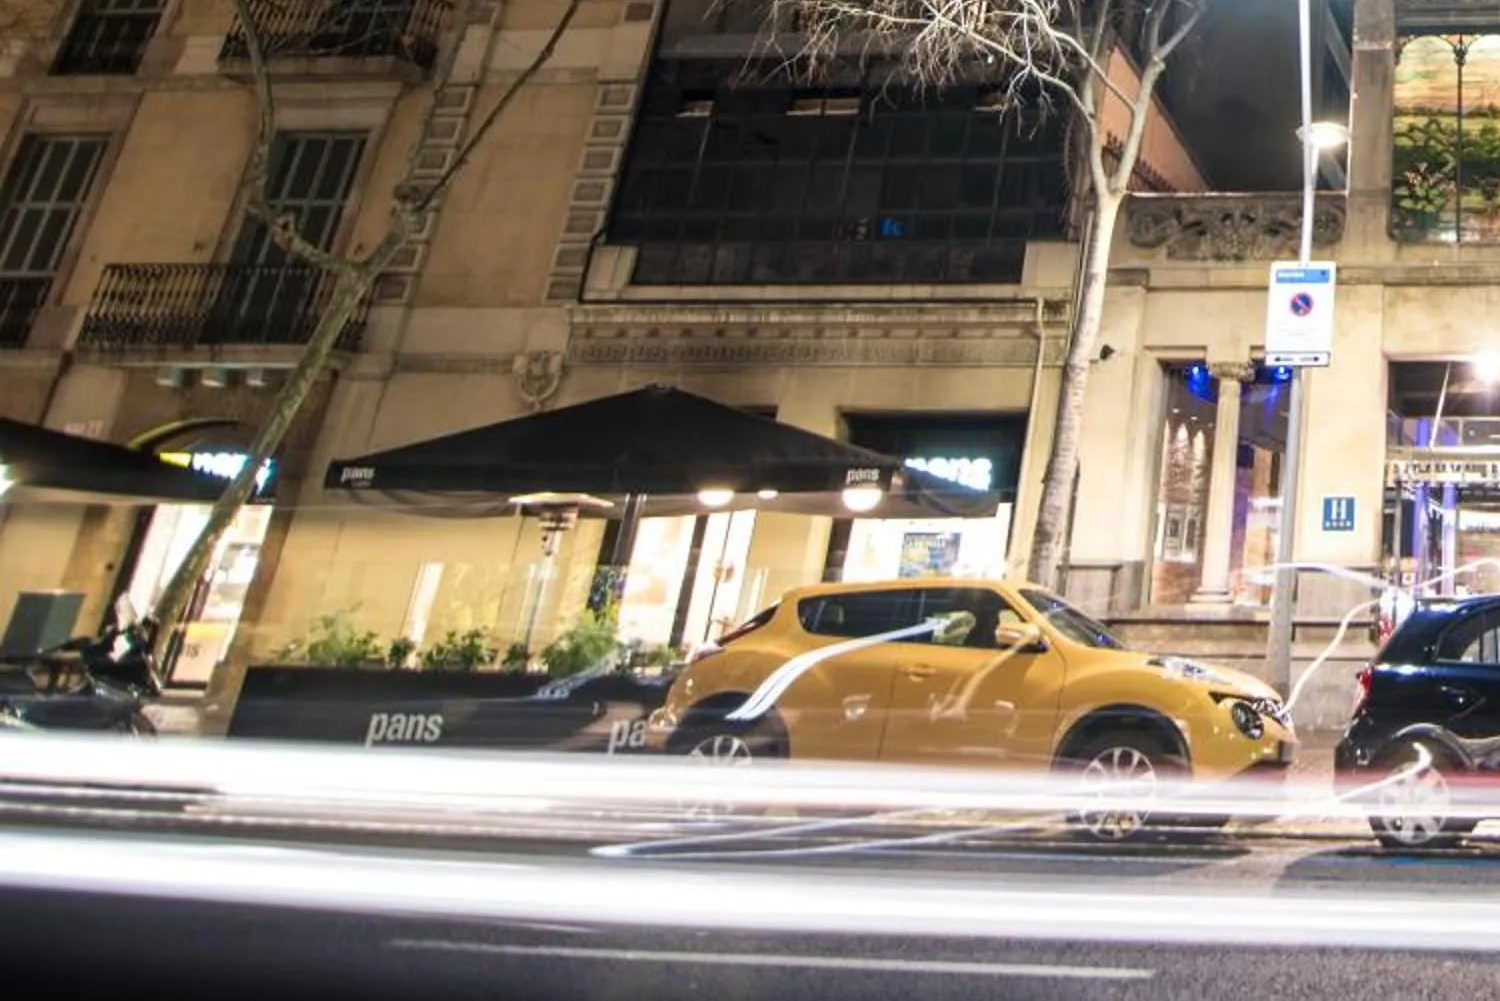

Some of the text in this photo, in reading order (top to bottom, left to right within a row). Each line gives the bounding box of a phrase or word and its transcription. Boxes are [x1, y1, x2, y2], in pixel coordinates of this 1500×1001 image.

[340, 467, 376, 484] pans
[846, 468, 880, 484] pans
[1331, 498, 1348, 520] H
[365, 711, 444, 750] pans
[608, 718, 648, 756] pa
